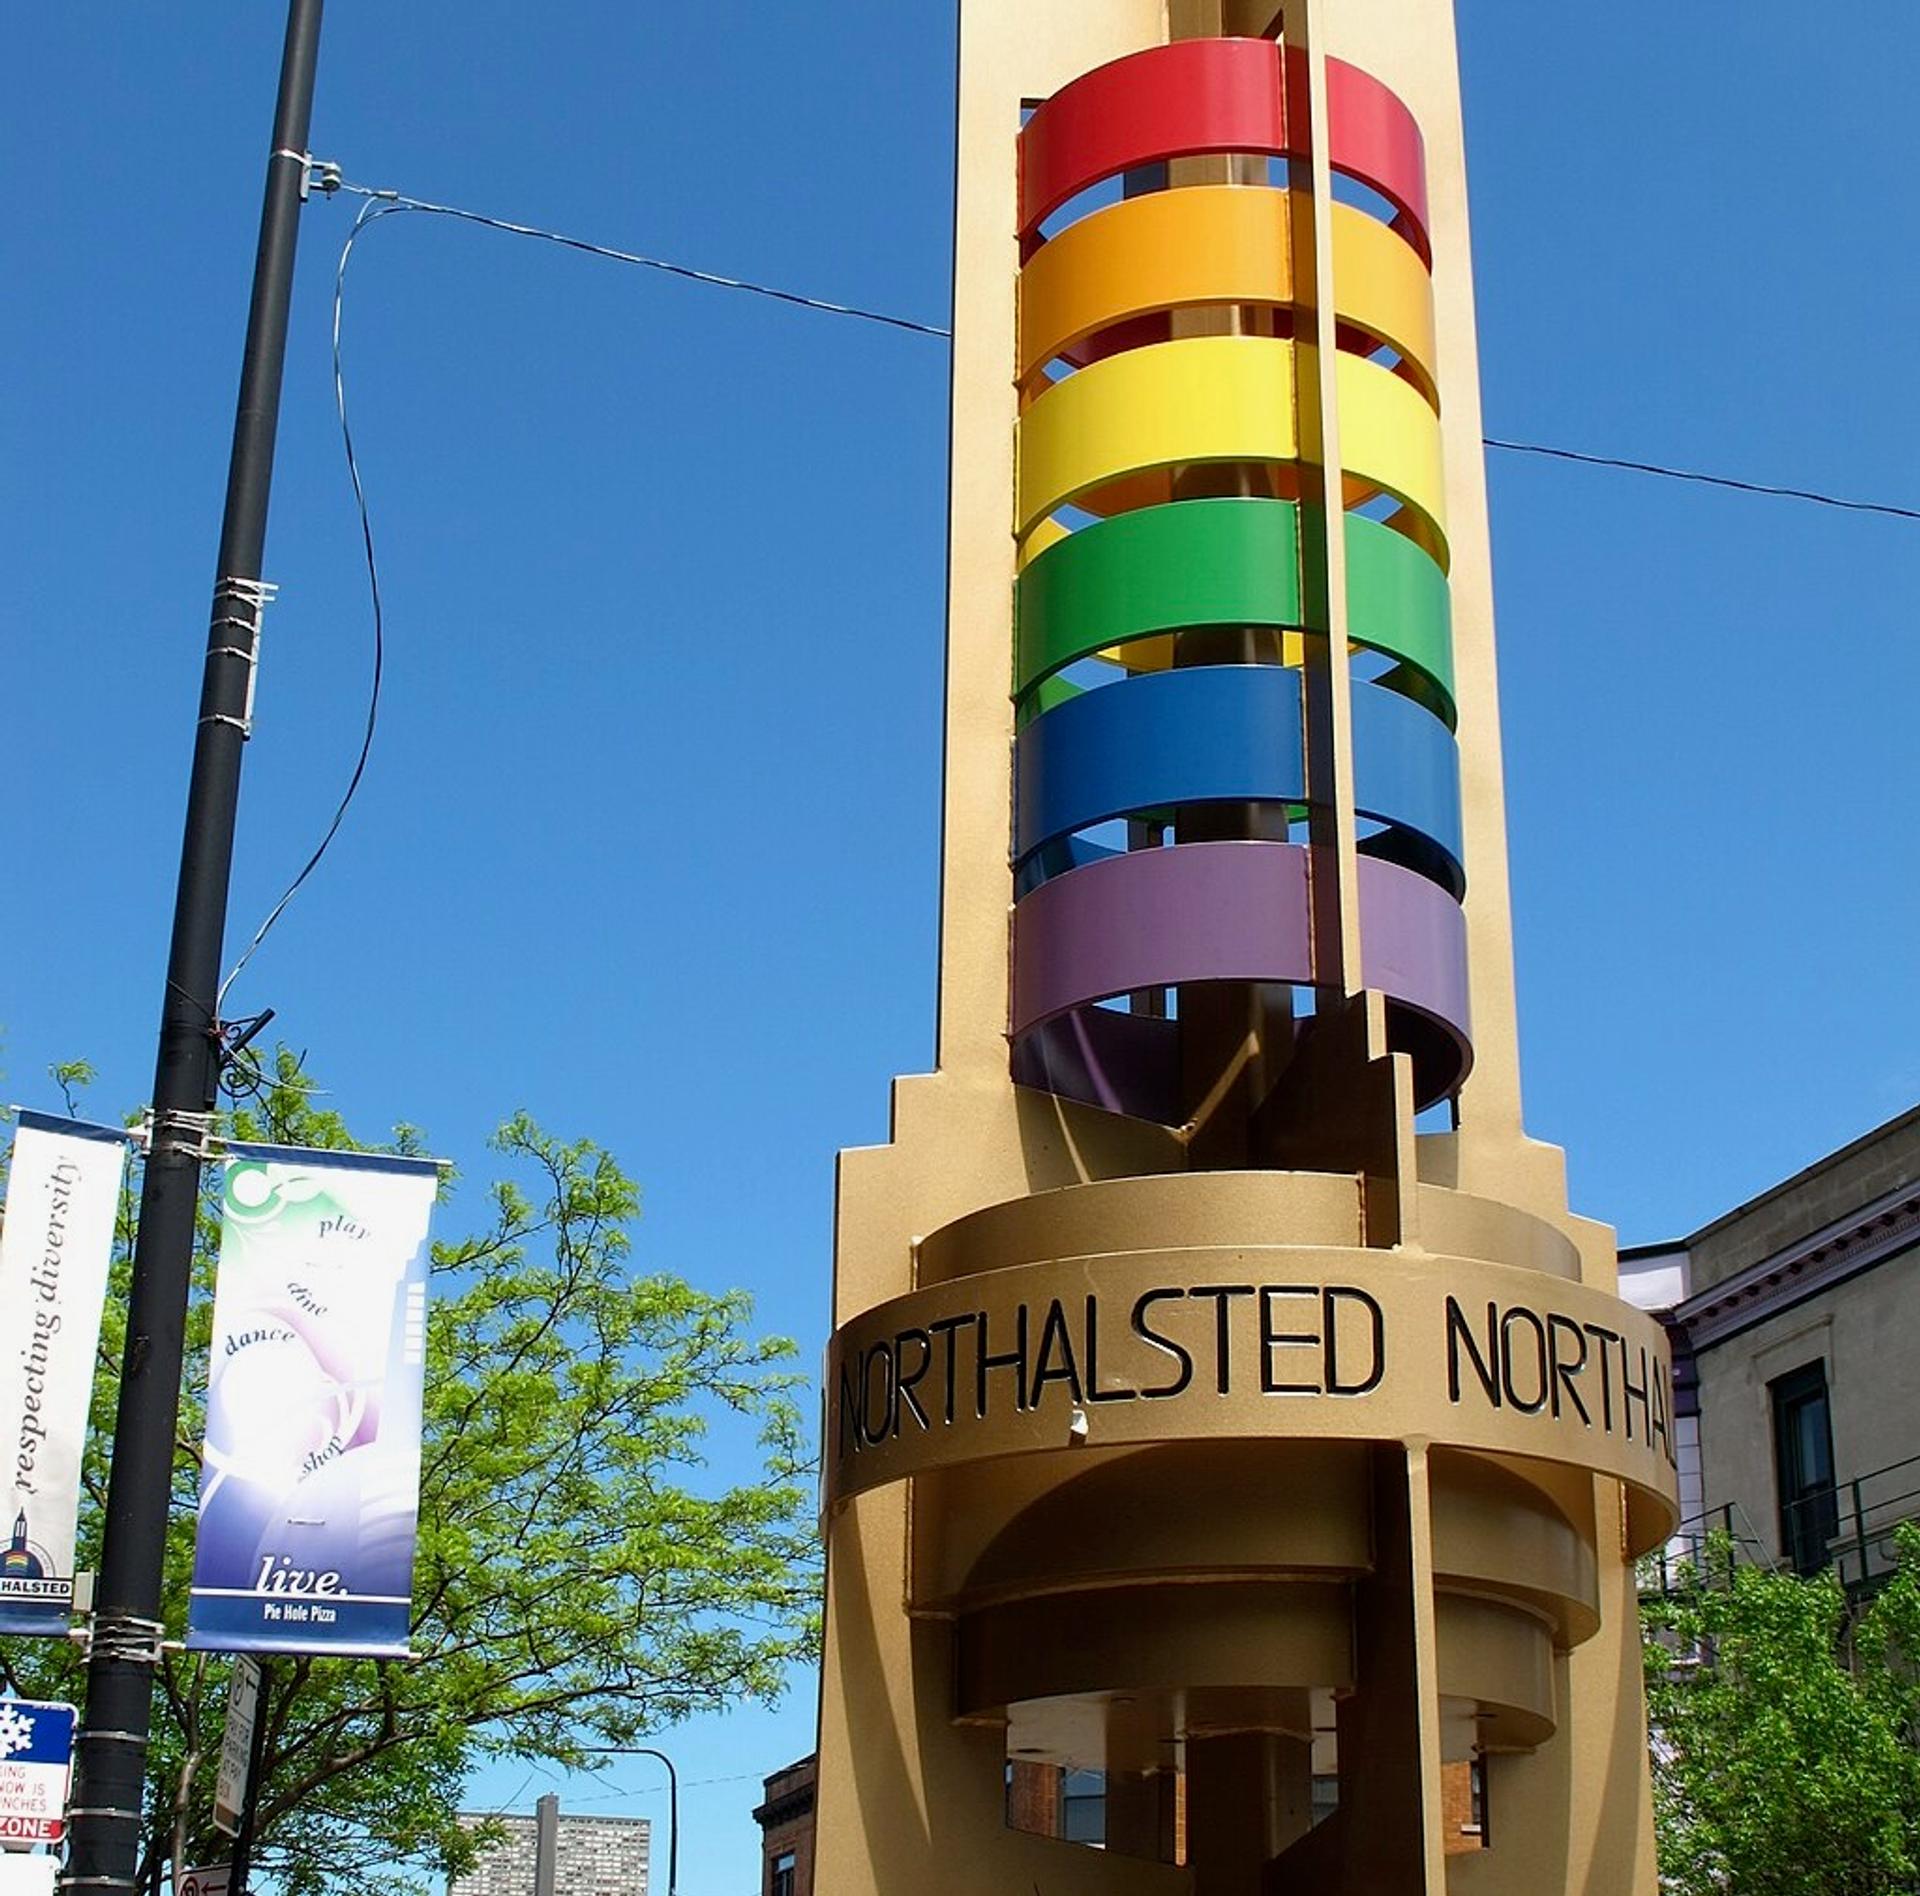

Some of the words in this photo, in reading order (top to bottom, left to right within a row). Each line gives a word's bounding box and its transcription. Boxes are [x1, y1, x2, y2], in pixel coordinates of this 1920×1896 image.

[30, 1155, 82, 1302] diversity
[319, 1215, 371, 1240] play
[287, 1282, 328, 1316] dine
[225, 1328, 296, 1356] dance
[837, 1284, 1385, 1460] NORTHALSTED
[15, 1300, 62, 1495] respecting
[299, 1435, 345, 1484] shop
[256, 1556, 348, 1597] live.
[264, 1603, 281, 1620] Pie
[283, 1604, 309, 1621] Hole
[311, 1605, 337, 1622] Pizza
[33, 1783, 46, 1796] IS
[0, 1817, 52, 1838] ZONE
